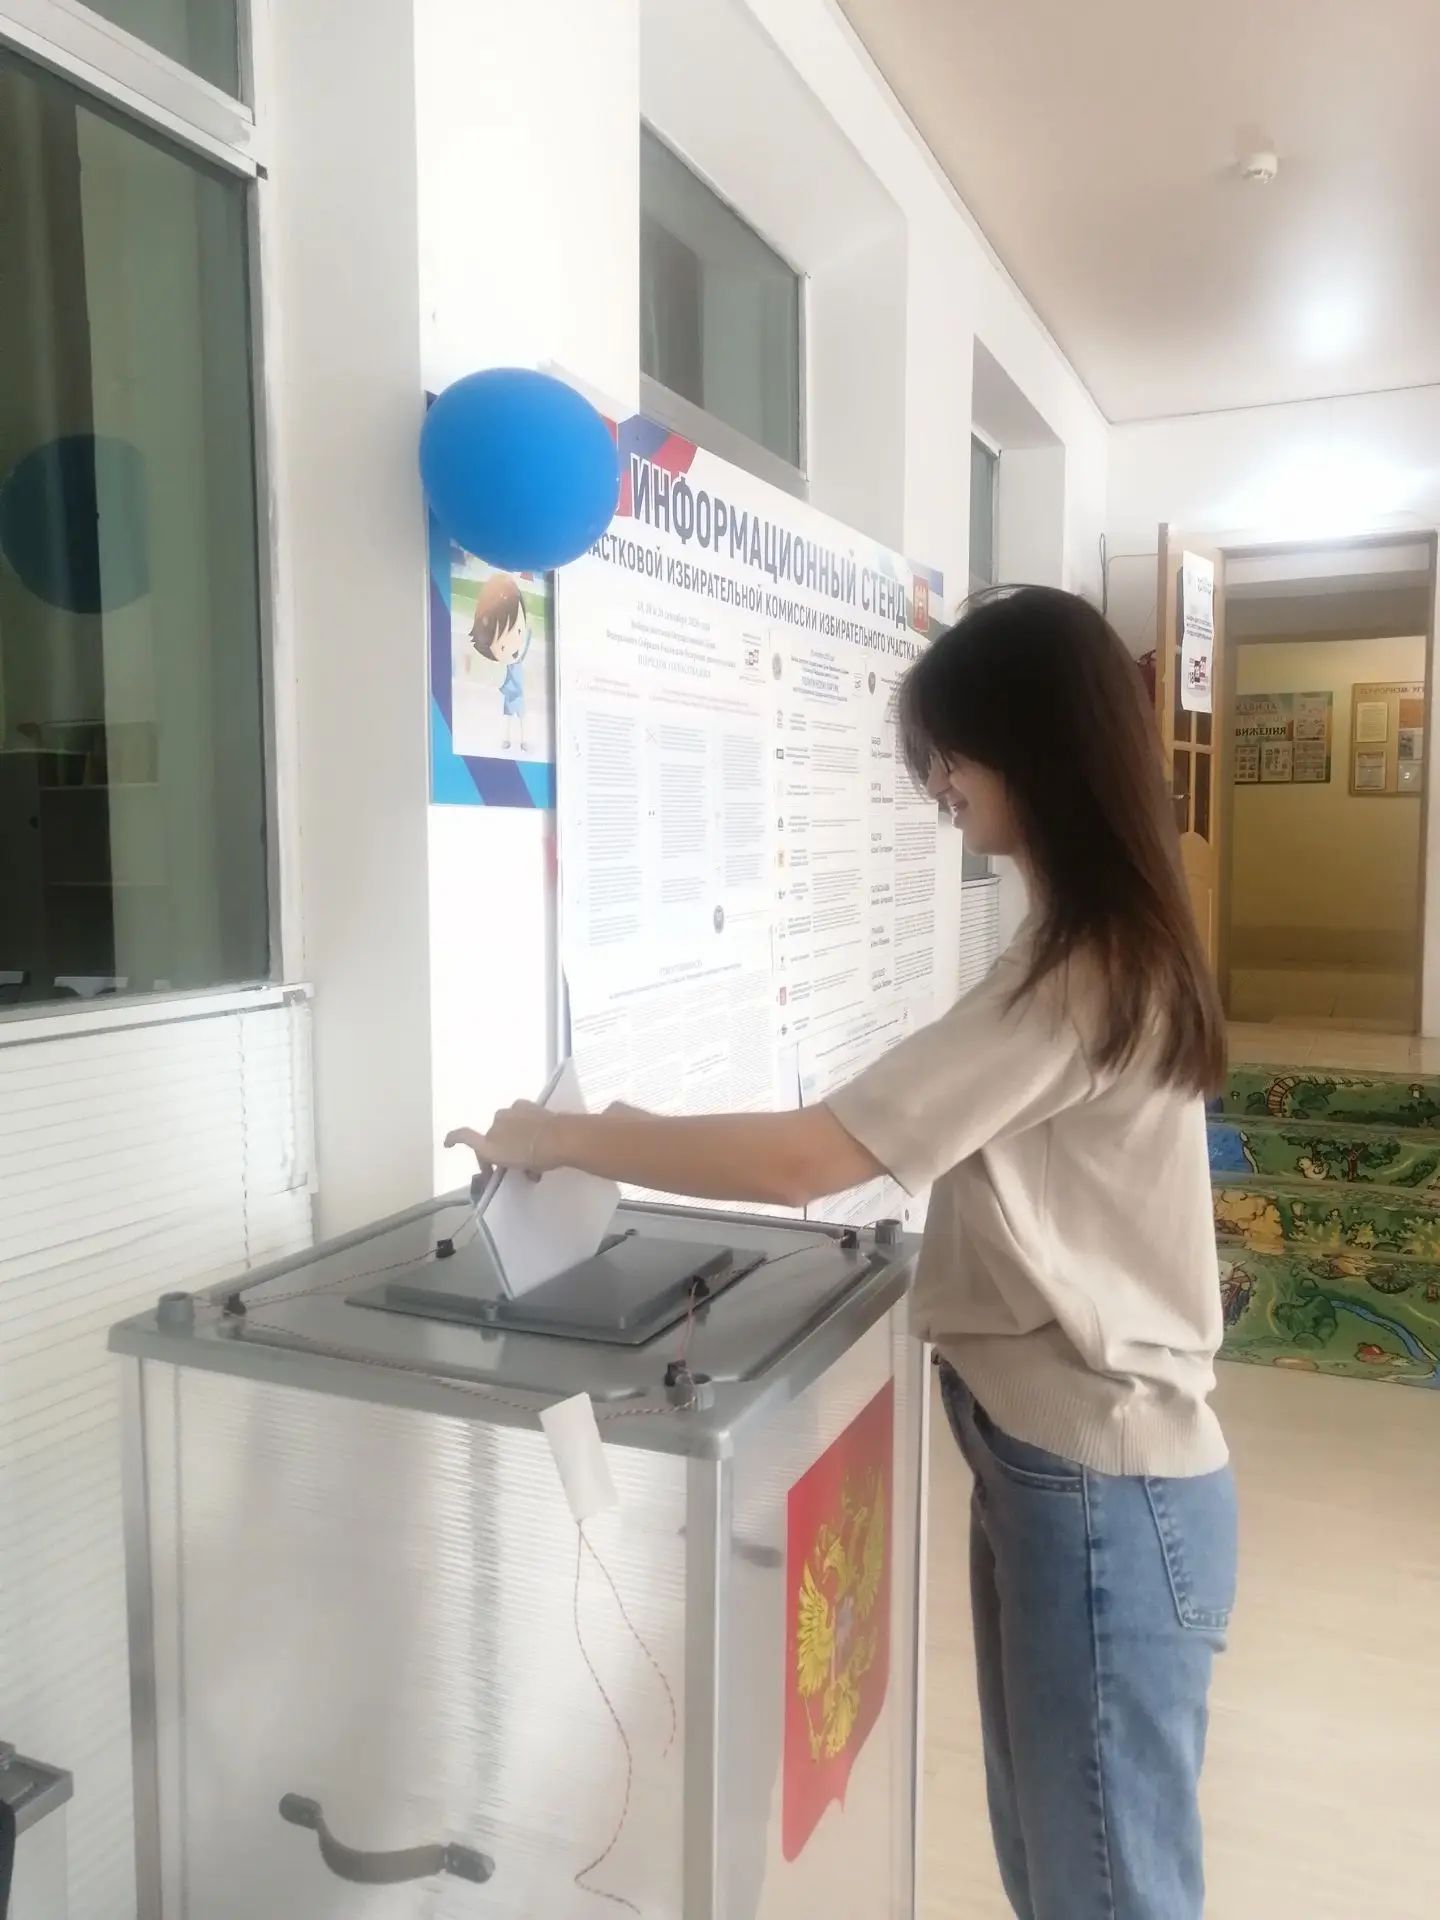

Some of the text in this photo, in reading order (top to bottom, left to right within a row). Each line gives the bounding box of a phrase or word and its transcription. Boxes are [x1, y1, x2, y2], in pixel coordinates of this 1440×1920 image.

[588, 534, 915, 661] АСТКОВОЙ ИЗБИРАТЕЛЬНОЙ КОМИССИИ ИЗБИРАТЕЛЬНОГО УЧАСТКА
[632, 458, 907, 630] ИНФОРМАЦИОННЫЙ СТЕНД
